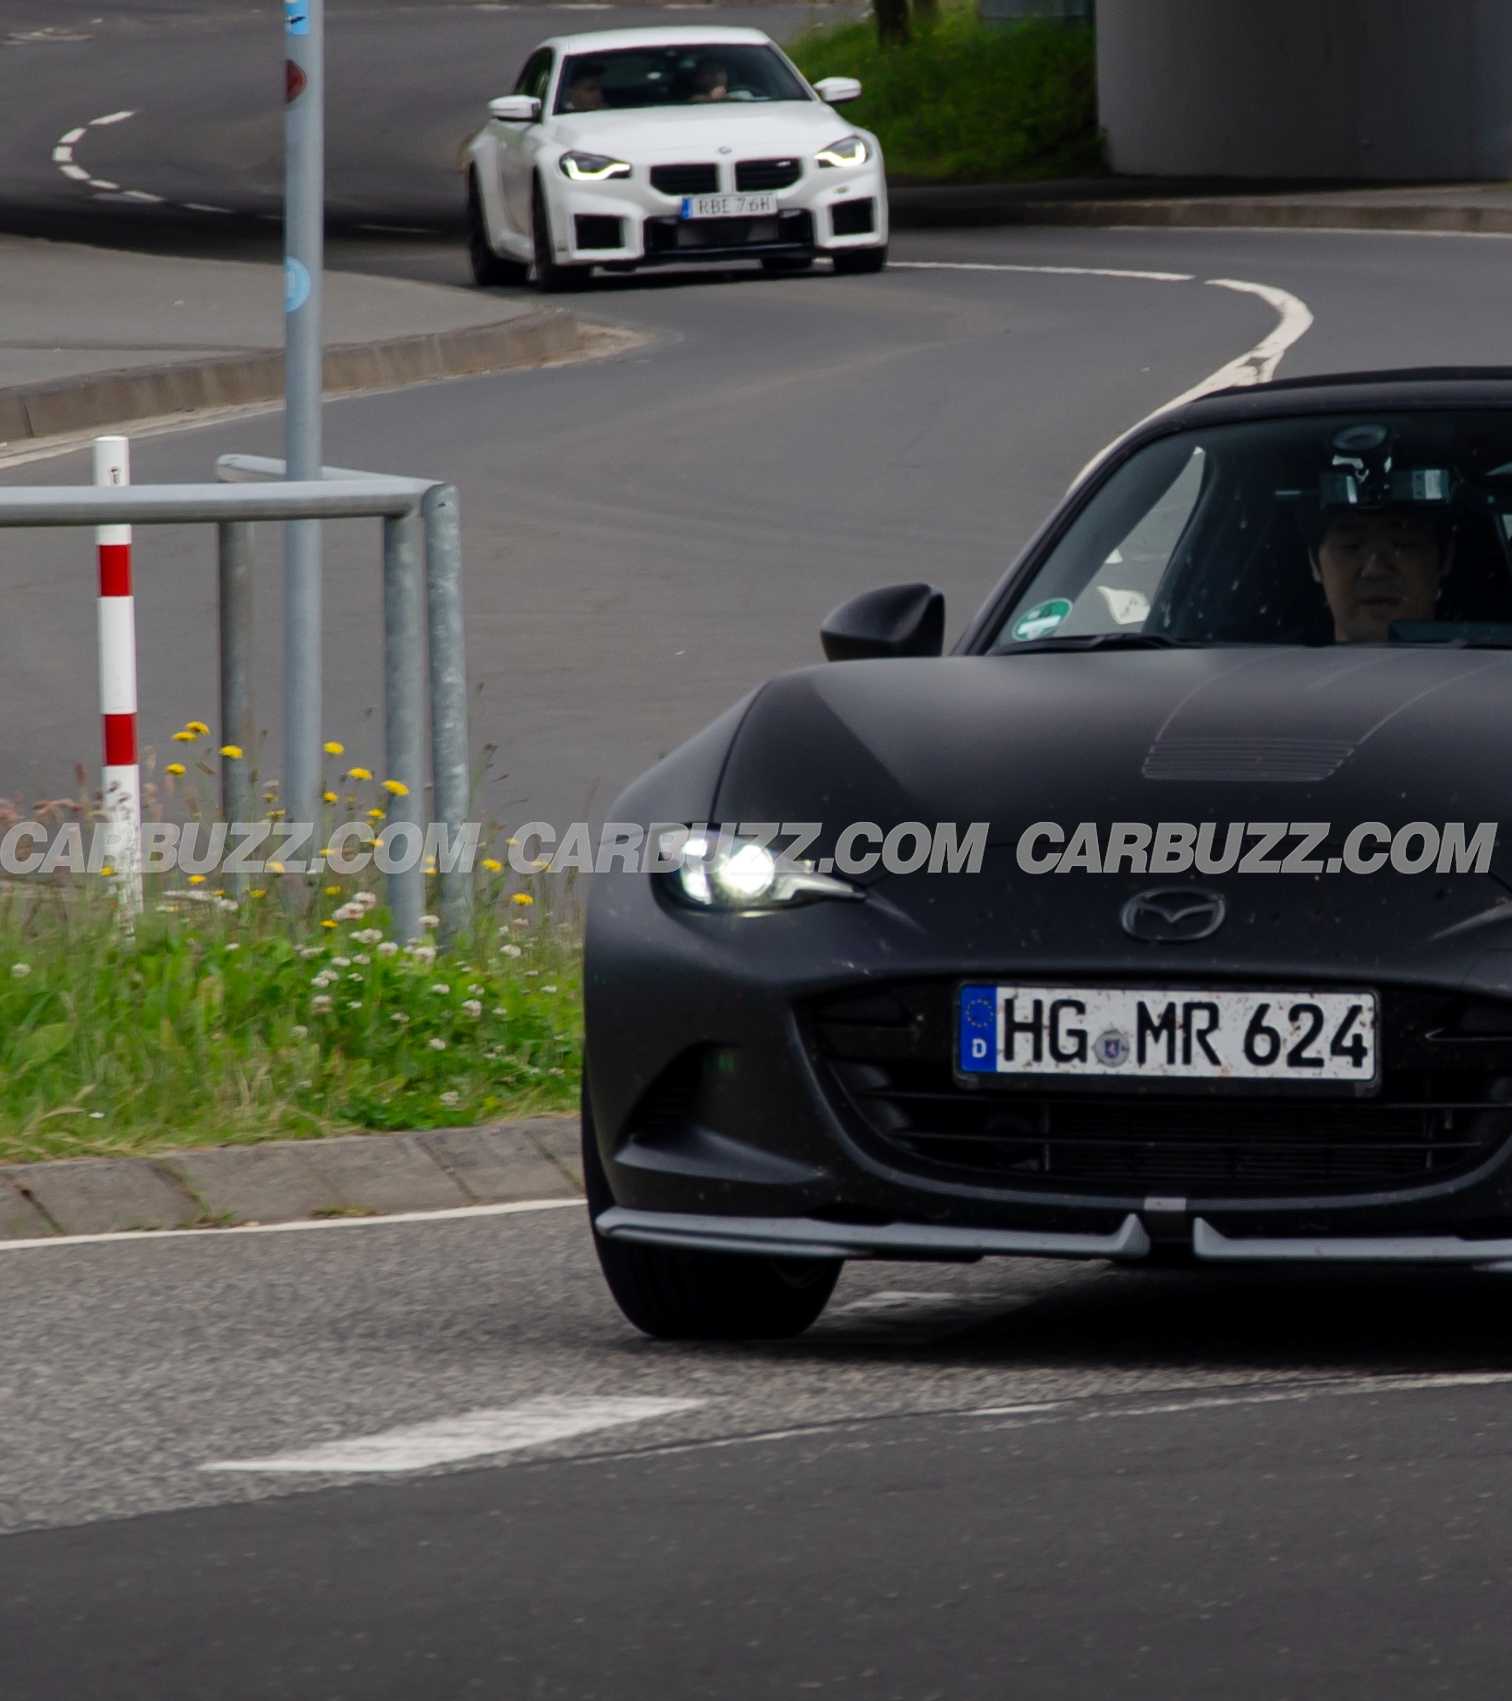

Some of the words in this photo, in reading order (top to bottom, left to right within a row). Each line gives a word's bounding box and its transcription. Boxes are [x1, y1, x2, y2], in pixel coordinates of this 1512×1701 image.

[971, 1038, 988, 1059] D
[1003, 998, 1088, 1063] HG
[1136, 1000, 1223, 1067] MR
[1243, 1002, 1369, 1069] 624
